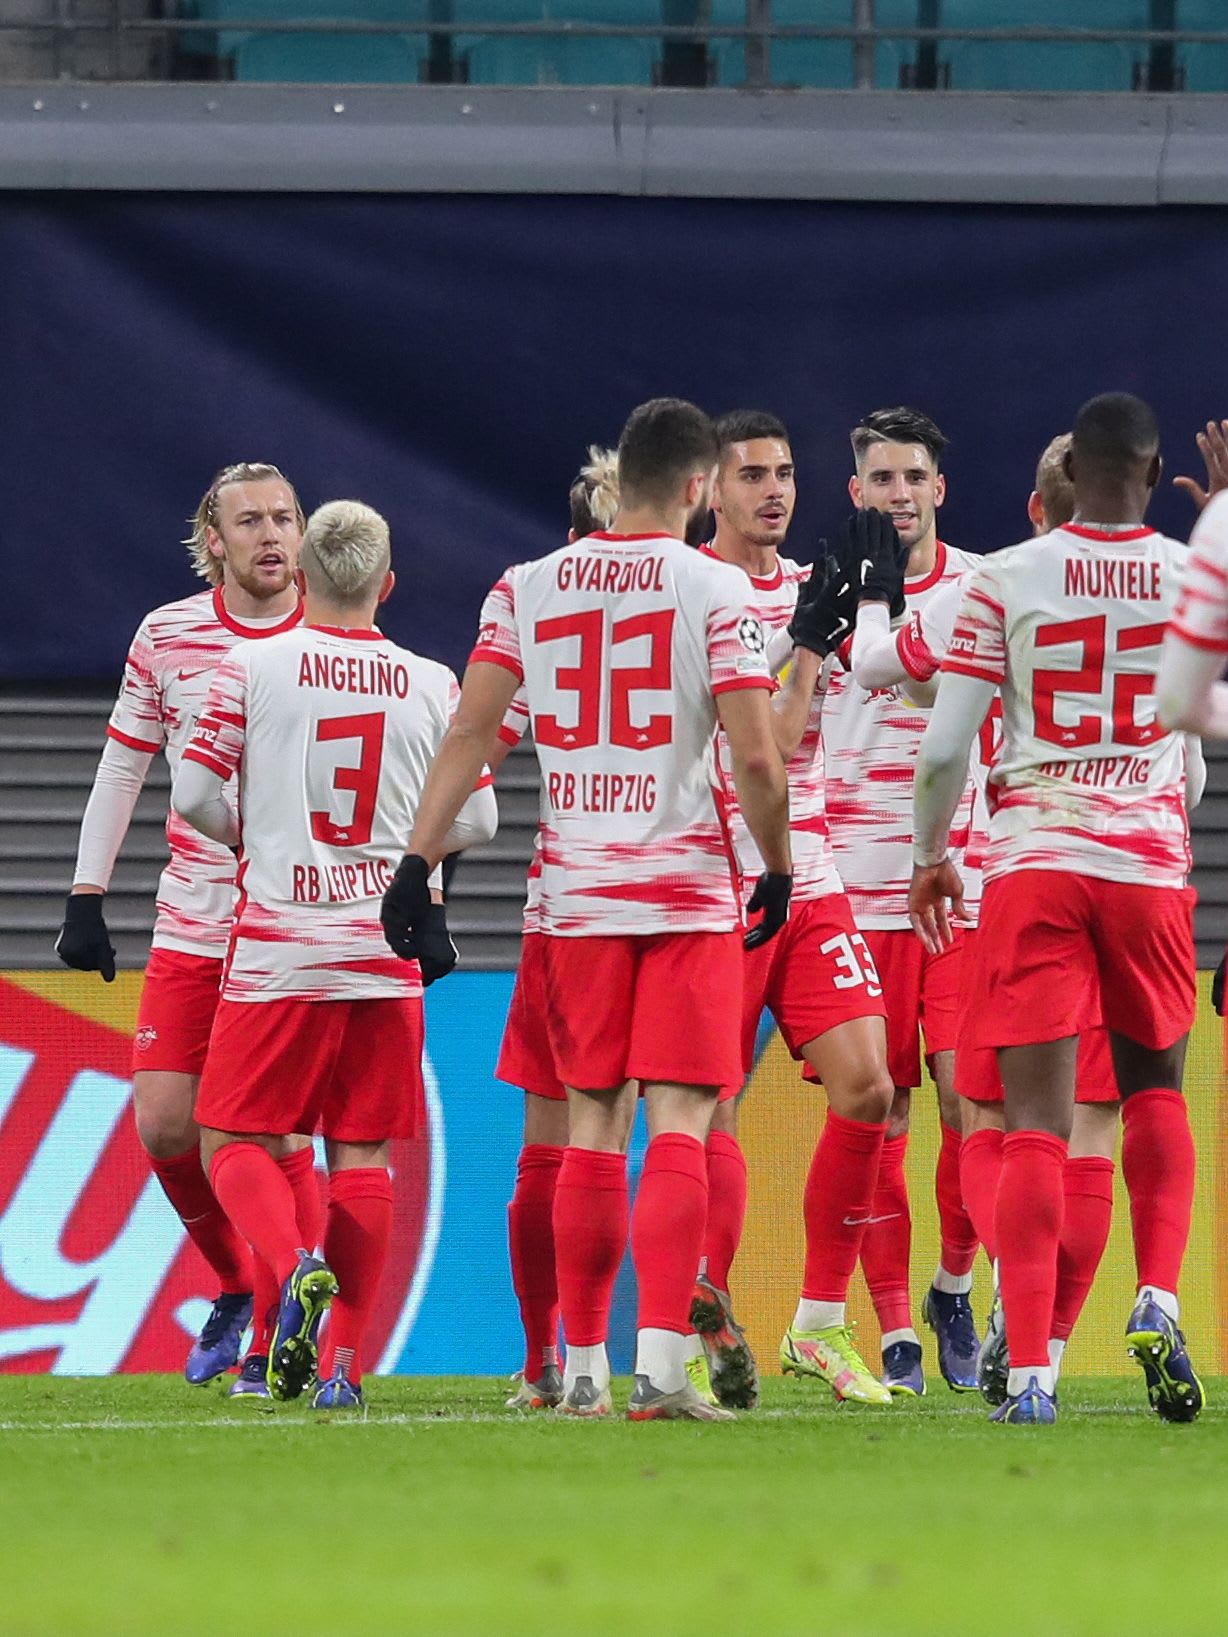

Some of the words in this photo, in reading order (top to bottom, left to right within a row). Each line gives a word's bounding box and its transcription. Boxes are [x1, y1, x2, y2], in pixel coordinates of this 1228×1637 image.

[557, 556, 663, 593] GVARDIOL
[1064, 558, 1162, 601] MUKIELE
[298, 651, 409, 700] ANGELIÑO
[534, 608, 676, 752] 32
[1032, 614, 1173, 749] 22
[310, 711, 386, 848] 3
[549, 772, 577, 811] RB
[582, 773, 657, 813] LEIPZIG
[293, 864, 320, 903] RB
[324, 859, 395, 903] LEIPZIG
[820, 931, 881, 990] 33
